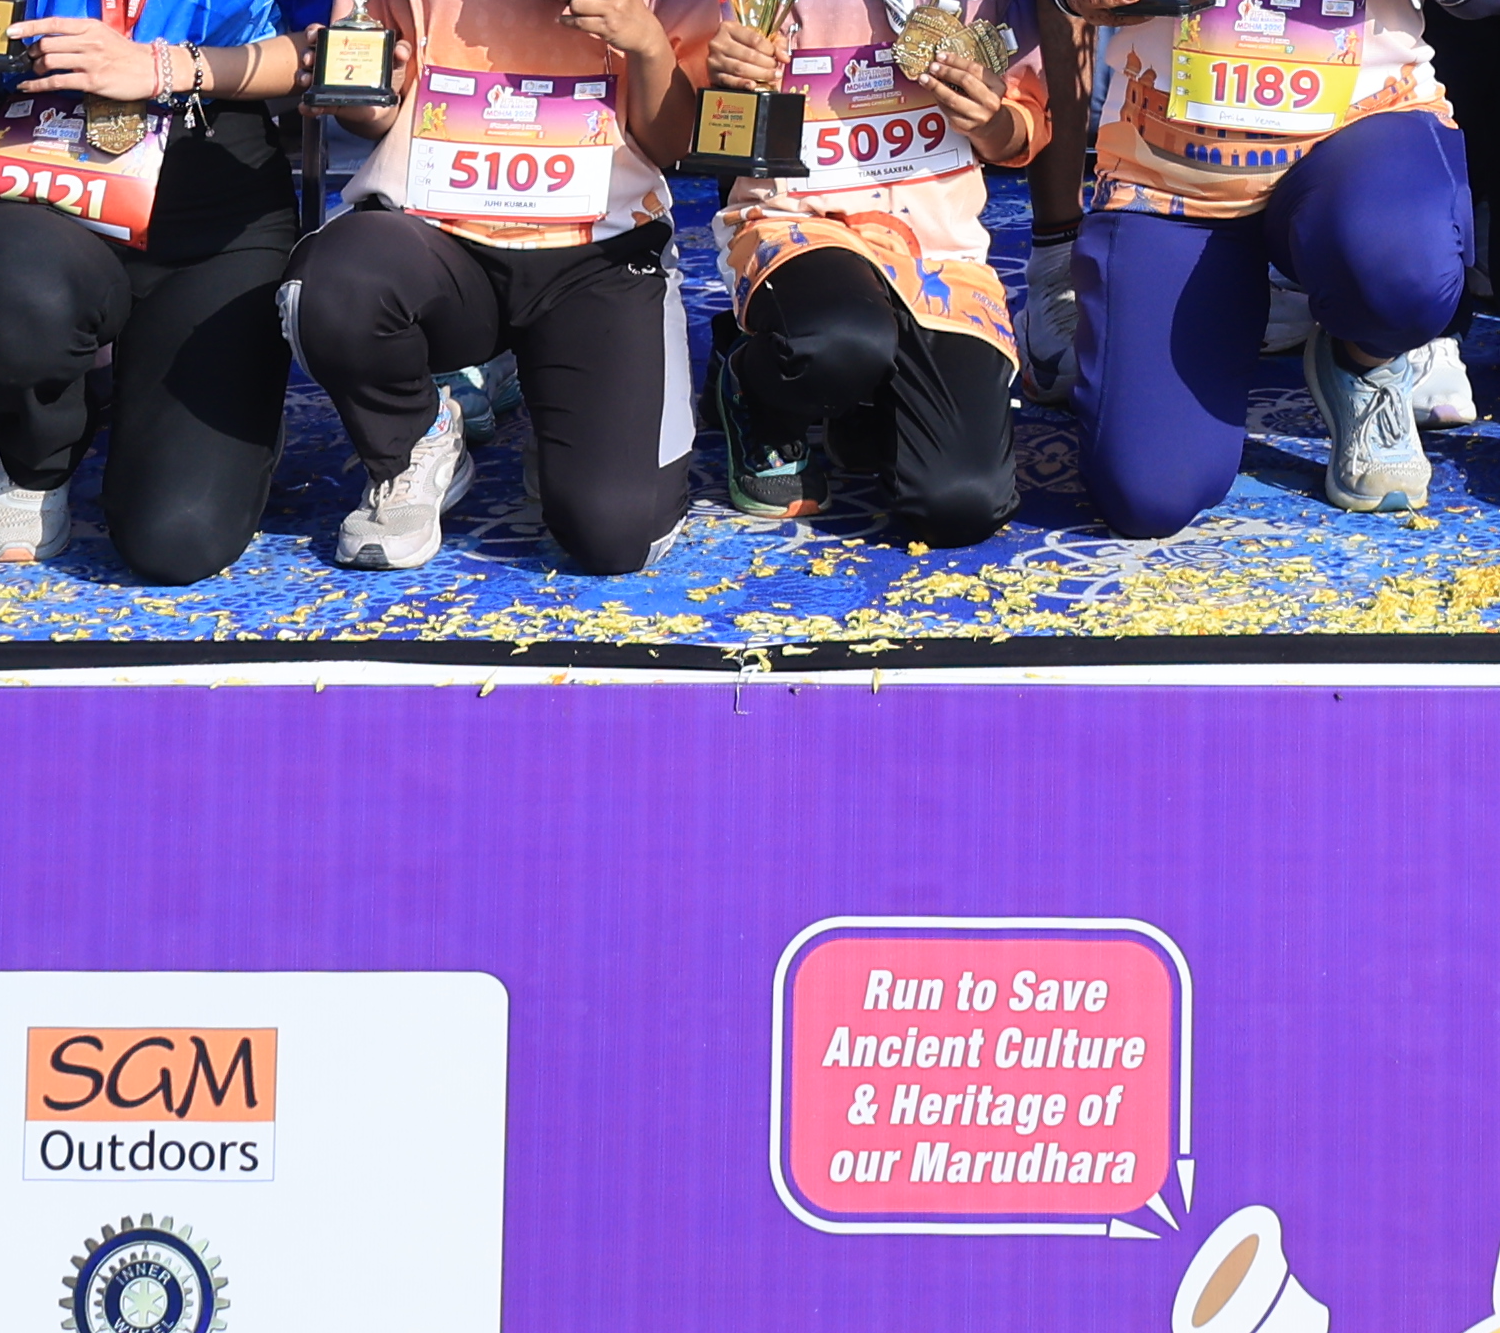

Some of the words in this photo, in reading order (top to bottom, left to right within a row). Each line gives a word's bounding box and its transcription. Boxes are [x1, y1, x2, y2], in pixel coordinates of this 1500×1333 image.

[1211, 61, 1321, 109] 1189
[817, 112, 946, 166] 5099
[0, 164, 107, 220] 2121
[449, 149, 576, 193] 5109
[882, 164, 915, 176] SAXENA
[863, 969, 946, 1012] Run
[956, 971, 997, 1012] to
[1008, 970, 1109, 1013] Save
[822, 1026, 984, 1069] Ancient
[994, 1027, 1146, 1070] Culture
[43, 1035, 260, 1118] SGM
[847, 1083, 878, 1125] &
[889, 1084, 1067, 1135] Heritage
[1078, 1084, 1125, 1127] of
[40, 1129, 260, 1172] Outdoors
[829, 1148, 900, 1183] our
[910, 1141, 1137, 1185] Marudhara
[115, 1260, 173, 1285] INNER
